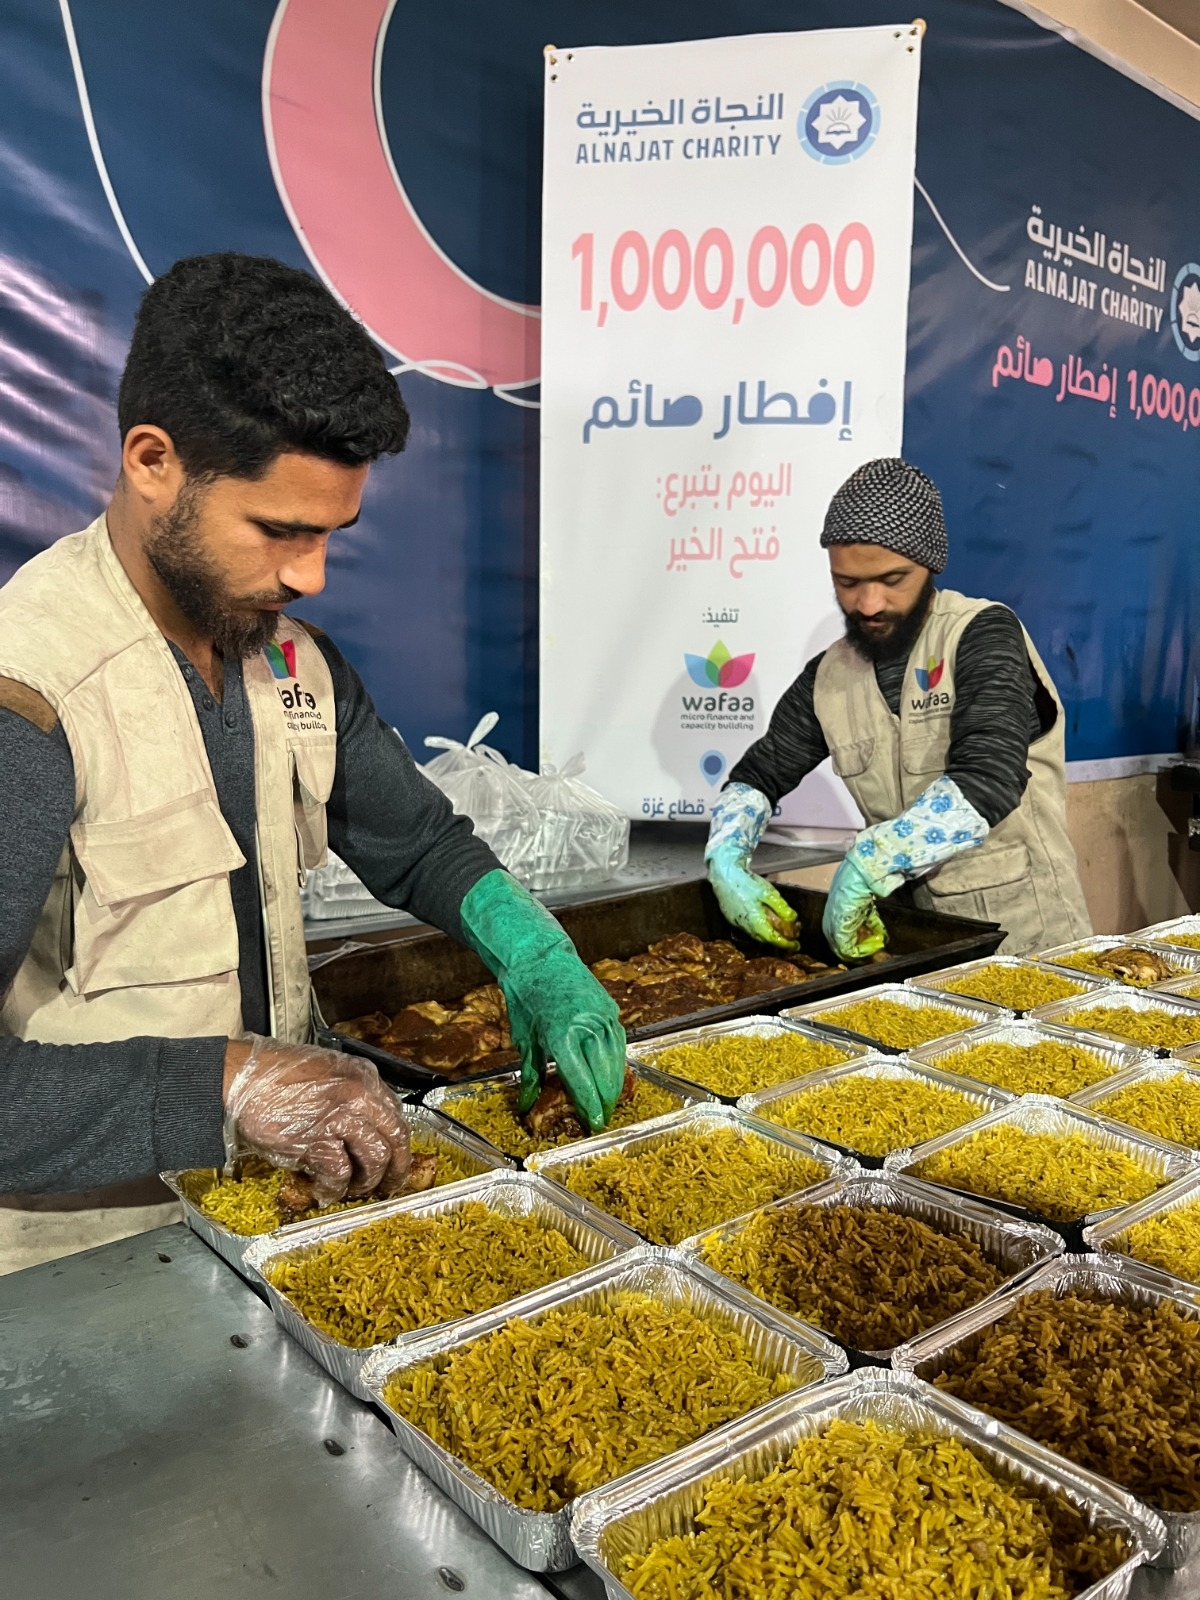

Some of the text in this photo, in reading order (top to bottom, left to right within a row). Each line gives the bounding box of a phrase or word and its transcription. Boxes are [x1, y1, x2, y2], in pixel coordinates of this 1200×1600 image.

[575, 92, 784, 137] النجاة الخيرية
[575, 134, 783, 165] ALNAJAT CHARITY
[1026, 204, 1167, 293] النجاة الخيرية
[571, 221, 876, 328] 1,000,000
[1024, 259, 1164, 333] ALNAJAT CHARITY
[992, 334, 1054, 388] صائم
[1055, 354, 1118, 418] إفطار
[582, 377, 853, 445] إفطار صائم
[726, 462, 793, 511] اليوم
[666, 525, 781, 579] فتح الخير
[680, 713, 755, 721] micro finance and
[680, 721, 755, 731] capacity building
[682, 692, 755, 712] wafaa
[641, 797, 705, 821] قطاع غزة
